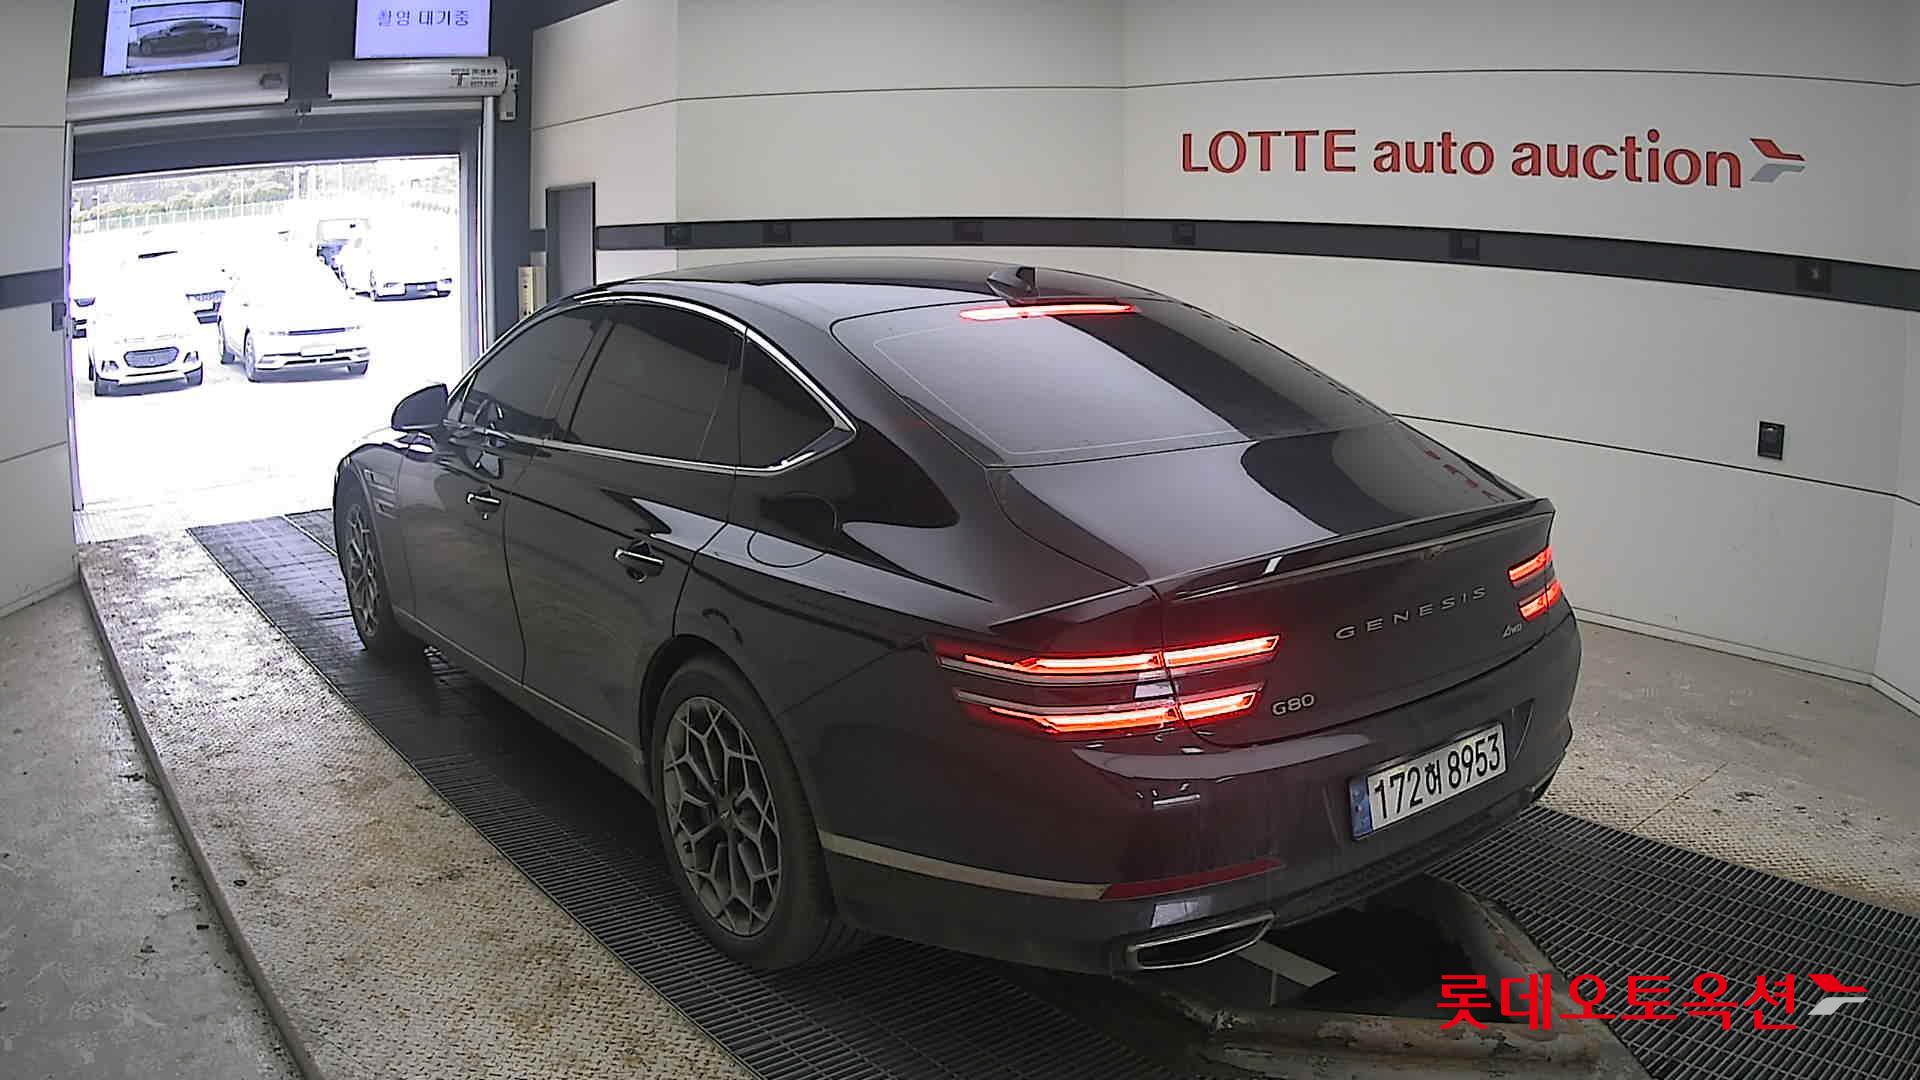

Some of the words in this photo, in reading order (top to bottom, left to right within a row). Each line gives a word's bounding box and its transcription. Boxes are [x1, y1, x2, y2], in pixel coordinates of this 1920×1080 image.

[419, 10, 469, 26] 대기중
[1183, 129, 1356, 174] LOTTE
[1373, 132, 1495, 176] auto
[1512, 129, 1743, 188] auction
[1335, 586, 1487, 640] GENESIS
[1272, 694, 1315, 716] G80
[1374, 760, 1442, 820] 172허
[1447, 733, 1501, 789] 8953
